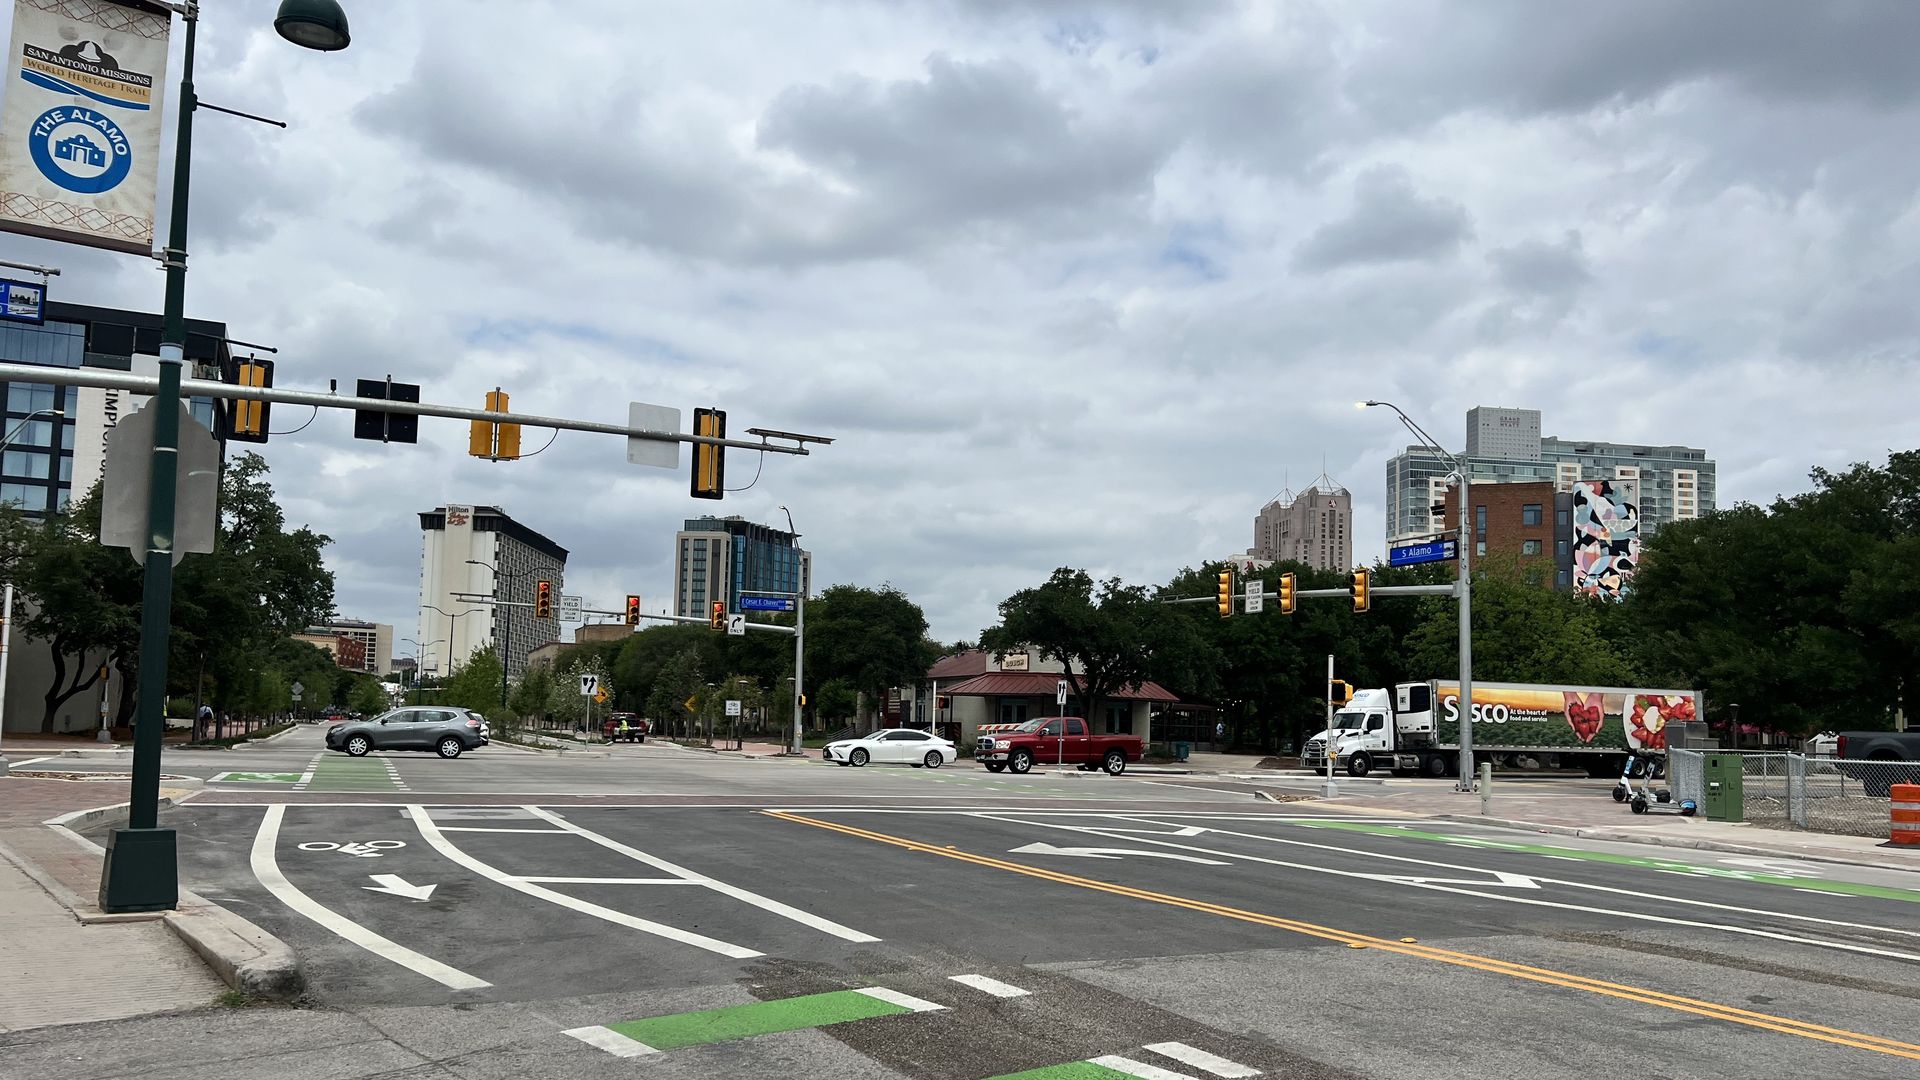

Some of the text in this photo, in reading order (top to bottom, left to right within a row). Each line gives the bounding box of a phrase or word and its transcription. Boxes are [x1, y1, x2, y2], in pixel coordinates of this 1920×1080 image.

[27, 47, 150, 85] SAN ANTONIO MISSIONS
[27, 58, 147, 96] WORLD HERITAGE TRAIL
[34, 109, 128, 156] THE ALAMO
[1402, 549, 1407, 558] S
[1408, 547, 1432, 557] Alamo
